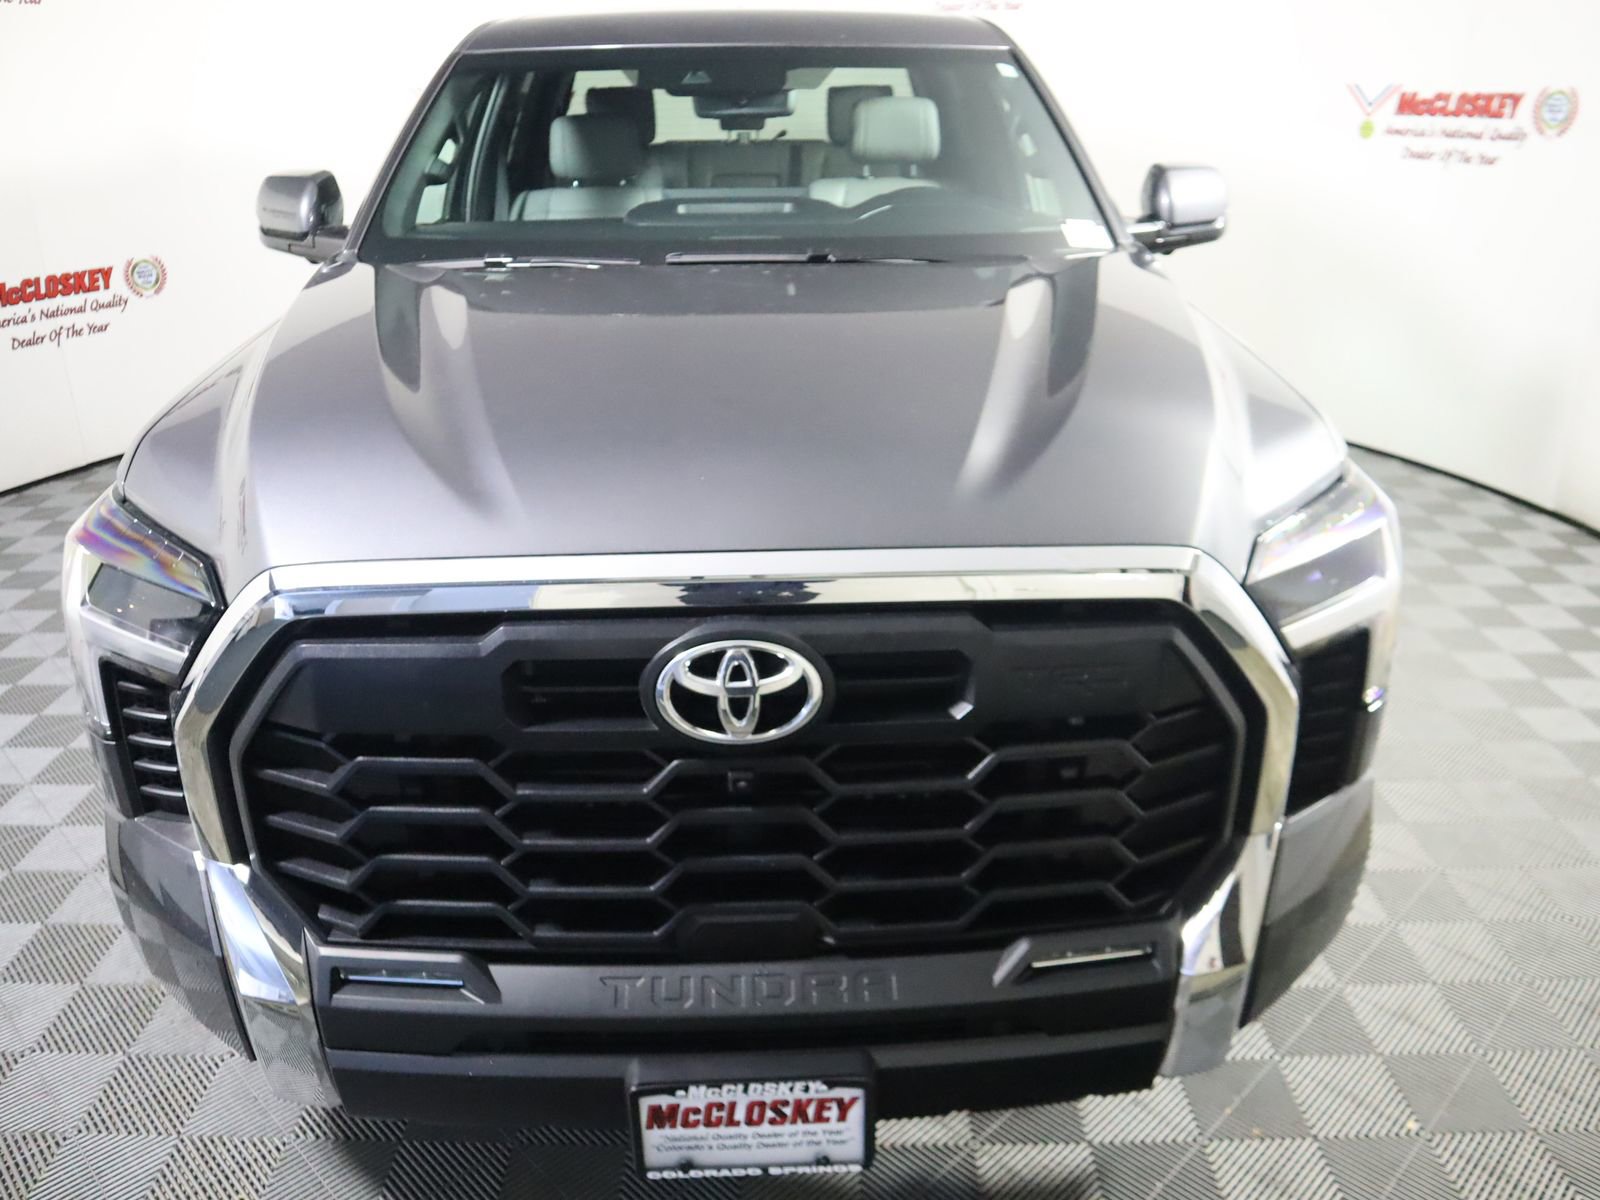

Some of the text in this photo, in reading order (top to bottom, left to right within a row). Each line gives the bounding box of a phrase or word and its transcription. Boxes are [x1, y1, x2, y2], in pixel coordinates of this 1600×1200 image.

[1395, 92, 1525, 119] McCLOSKEY
[40, 298, 87, 322] National
[90, 293, 129, 313] Quality
[11, 322, 110, 350] Dealer Of The Year
[599, 970, 899, 1009] TUNDRA
[688, 1081, 820, 1098] McCLOSKEY
[645, 1097, 859, 1130] McCLOSKEY
[646, 1164, 864, 1180] COLORADO SPRINGS
